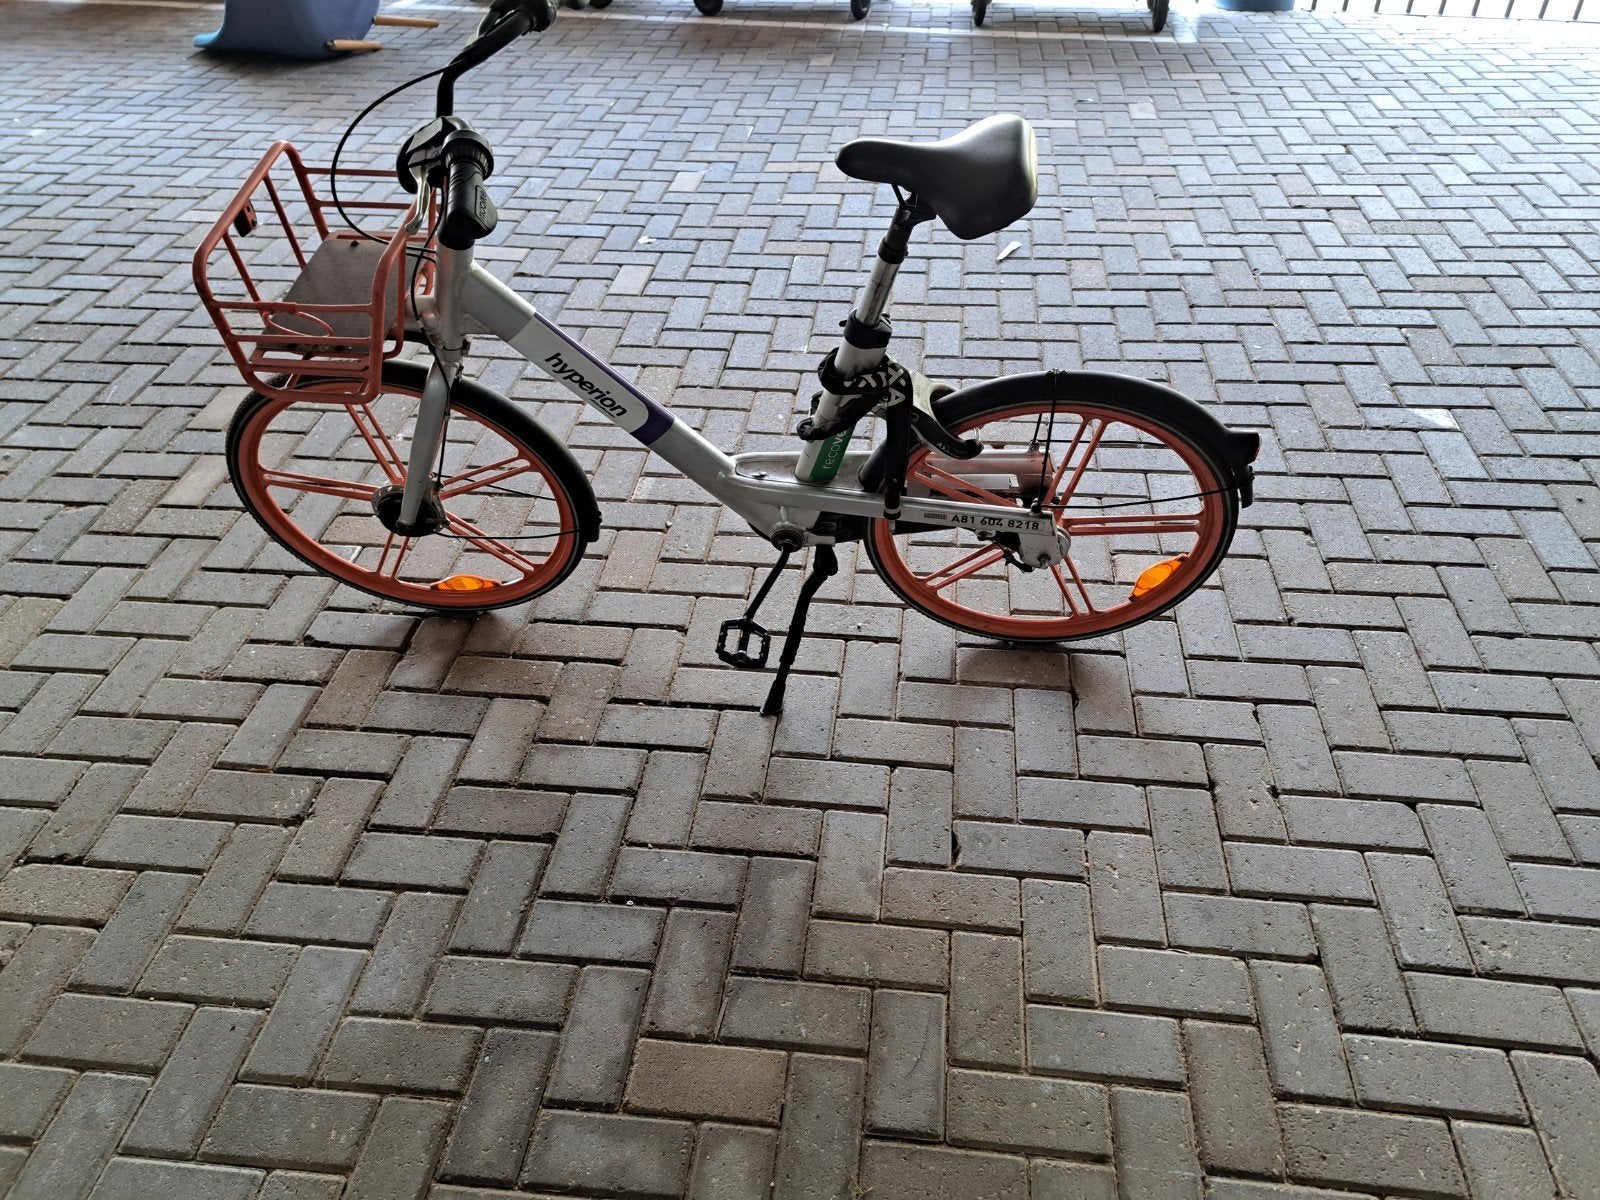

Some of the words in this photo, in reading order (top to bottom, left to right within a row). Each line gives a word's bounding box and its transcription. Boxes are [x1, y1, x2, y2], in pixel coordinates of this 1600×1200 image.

[544, 352, 628, 417] hyperion
[951, 514, 976, 525] A81
[980, 517, 1003, 527] 604
[1007, 520, 1040, 531] 8218
